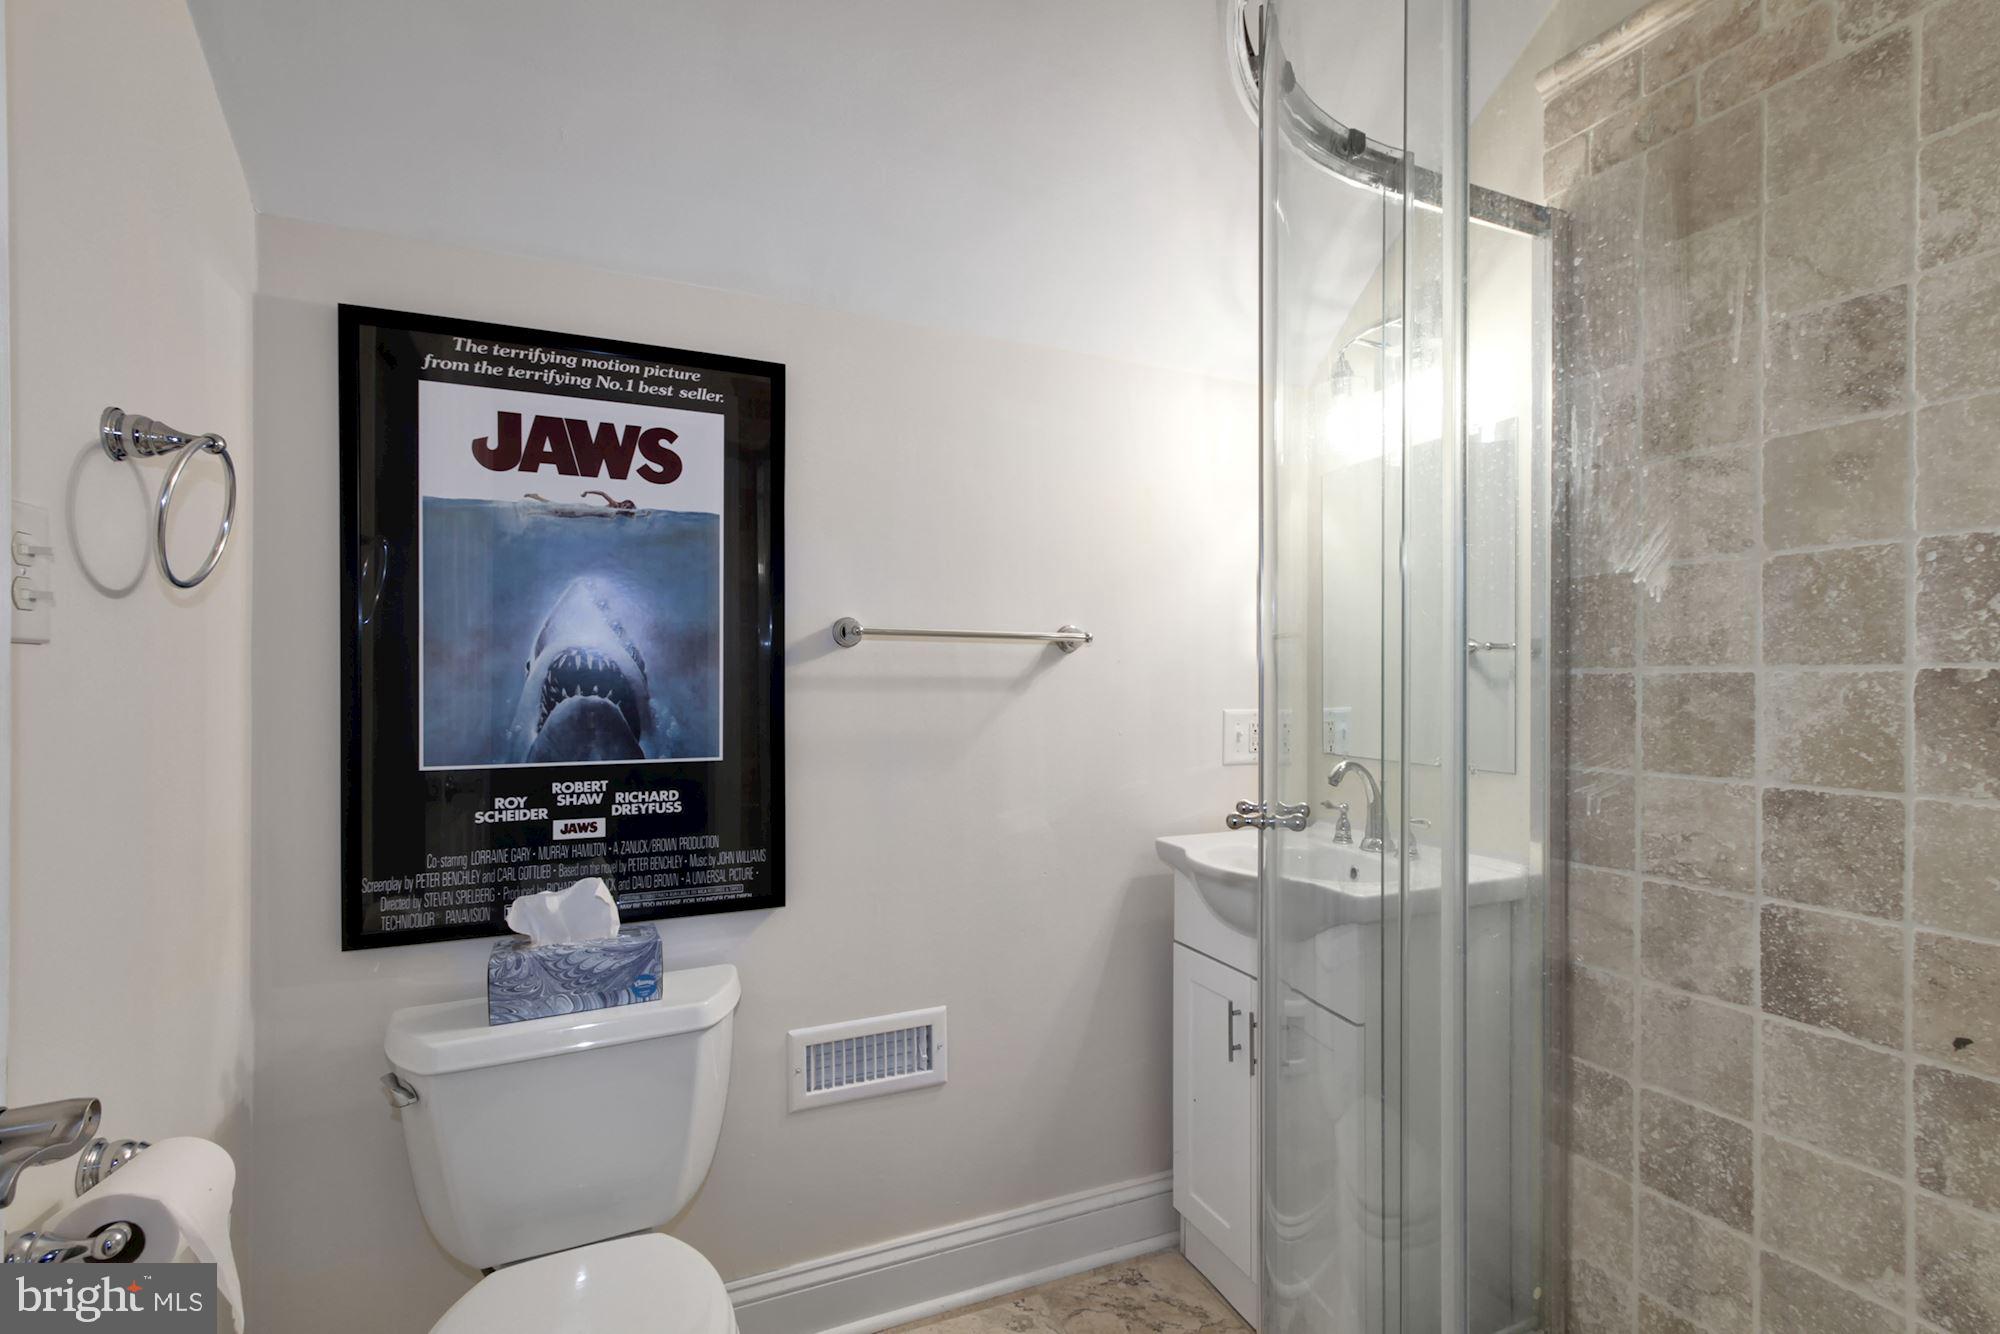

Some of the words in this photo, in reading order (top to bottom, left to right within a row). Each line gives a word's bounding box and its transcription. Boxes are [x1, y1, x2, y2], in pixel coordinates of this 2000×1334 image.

[453, 337, 488, 355] The
[492, 343, 578, 368] terrifying
[581, 356, 641, 374] motion
[643, 365, 701, 383] picture
[421, 354, 470, 372] from
[474, 361, 503, 376] the
[507, 366, 592, 390] terrifying
[638, 381, 674, 397] best
[679, 388, 724, 403] seller.
[471, 410, 683, 485] JAWS
[551, 780, 609, 794] ROBERT
[615, 790, 680, 804] RICHARD
[494, 796, 528, 810] ROY
[556, 793, 604, 807] SHAW
[611, 801, 682, 816] DREYFUSS
[474, 808, 549, 824] SCHEIDER
[560, 821, 598, 835] JAWS
[471, 848, 508, 865] LORRAINE
[510, 847, 532, 862] GARY
[538, 844, 570, 861] MURRAY
[571, 842, 607, 858] HAMILTON
[612, 843, 620, 855] A
[679, 835, 720, 850] PRODUCTION
[361, 876, 402, 894] Screenplay
[404, 875, 414, 893] by
[415, 872, 441, 889] PETER
[442, 869, 481, 887] BENCHLEY
[482, 870, 496, 884] and
[497, 867, 517, 882] CARL
[518, 864, 551, 880] GOTTLIEB
[558, 862, 580, 878] Based
[580, 865, 589, 876] on
[589, 863, 601, 875] the
[618, 859, 627, 875] by
[628, 857, 649, 872] PETER
[650, 854, 684, 870] BENCHLEY
[716, 850, 735, 865] JOHN
[735, 848, 767, 864] WILLIAMS
[380, 894, 411, 912] Directed
[412, 894, 422, 911] by
[423, 891, 454, 908] STEVEN
[455, 887, 495, 906] SPIELBERG
[632, 874, 652, 889] DAVID
[381, 911, 435, 931] TECHNICOLOR
[445, 907, 491, 924] PANAVISION
